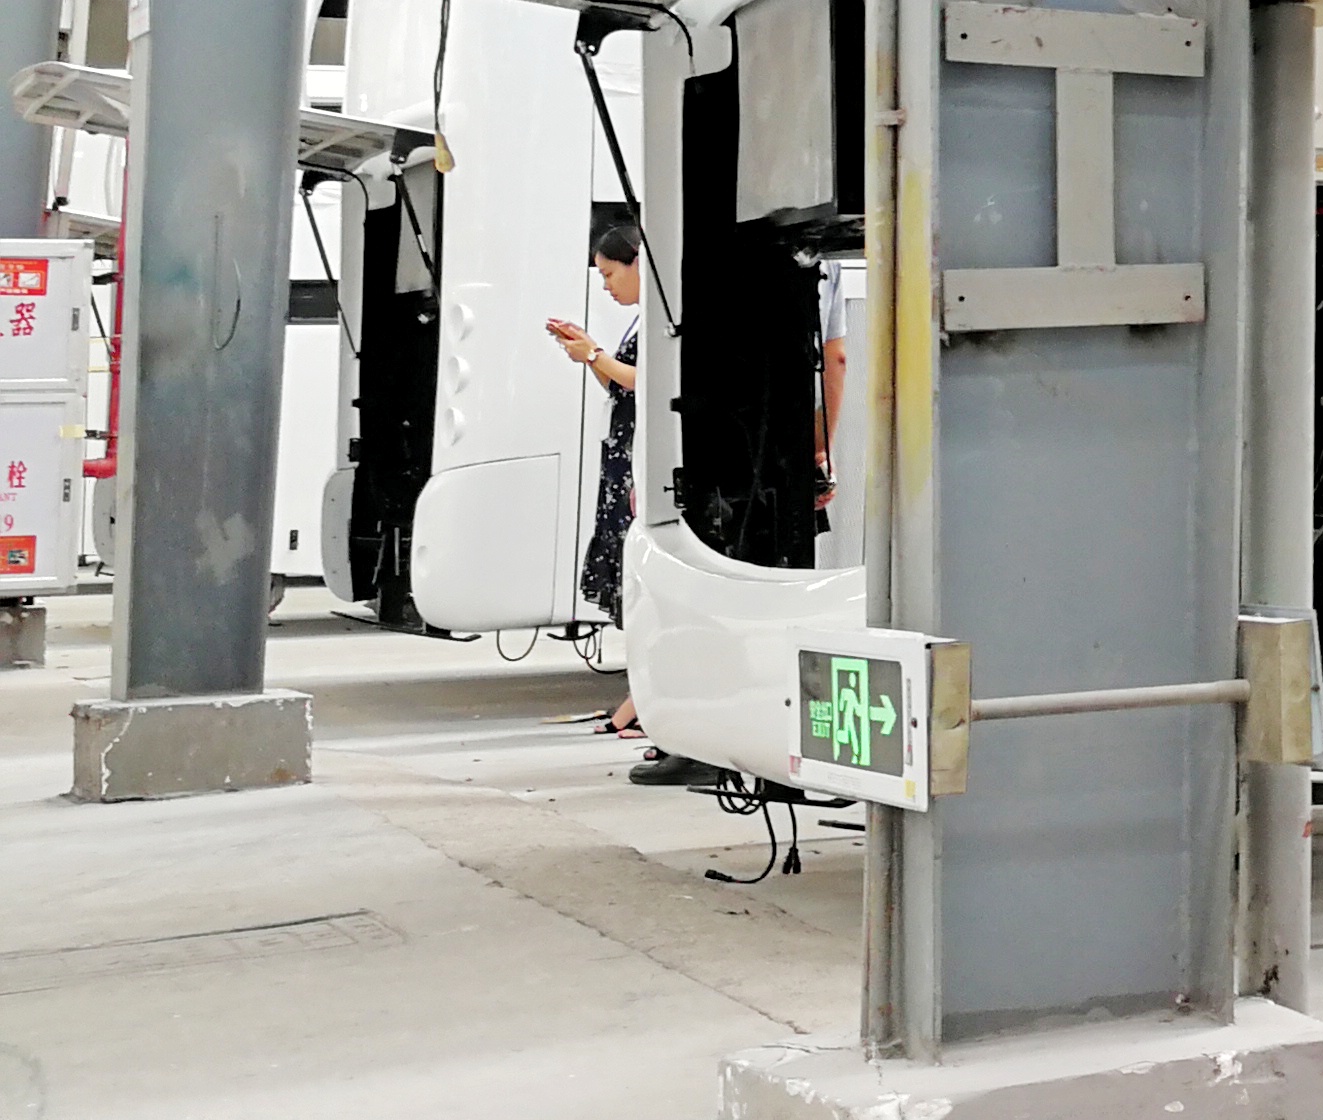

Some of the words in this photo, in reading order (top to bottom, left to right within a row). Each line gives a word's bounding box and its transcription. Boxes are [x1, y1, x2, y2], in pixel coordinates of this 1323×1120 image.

[0, 302, 36, 336] 器
[8, 461, 27, 488] 栓
[812, 721, 830, 738] EXIT
